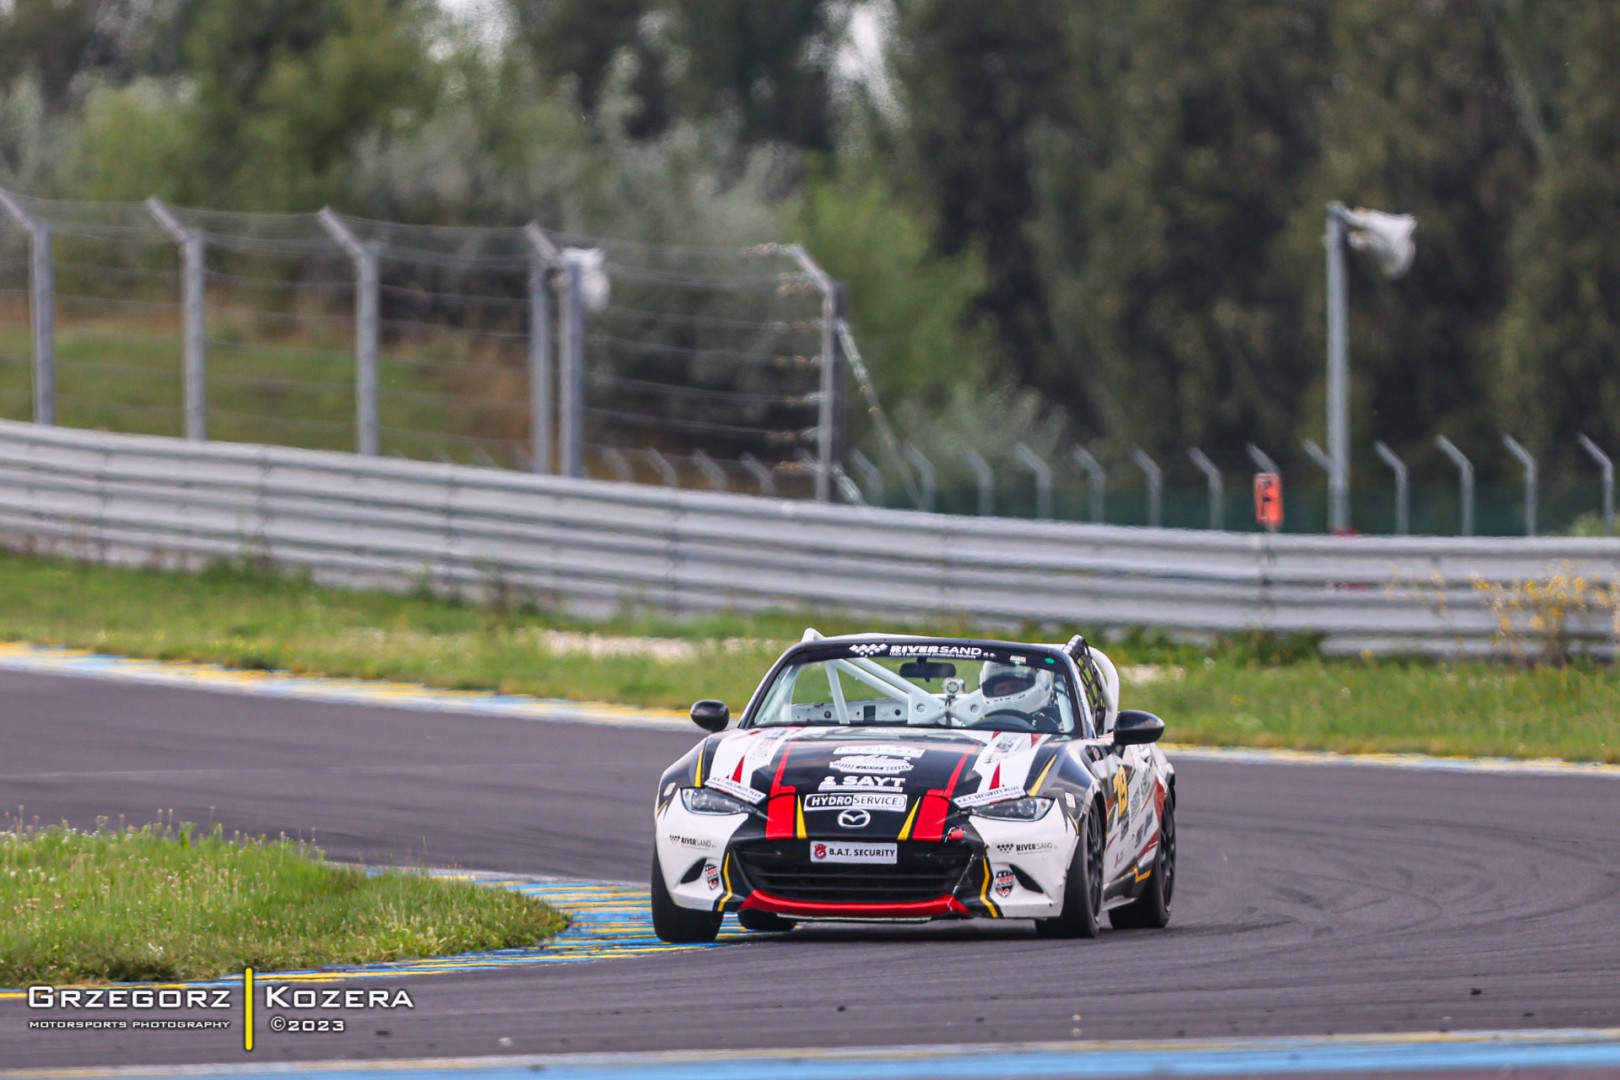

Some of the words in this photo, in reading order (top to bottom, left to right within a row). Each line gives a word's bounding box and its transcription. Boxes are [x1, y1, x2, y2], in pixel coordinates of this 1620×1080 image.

[889, 644, 982, 656] RIVERSAND
[819, 775, 836, 786] &
[842, 775, 906, 788] SAYT
[974, 788, 1003, 800] SECURITY
[829, 848, 852, 857] B.A.T.
[854, 848, 896, 857] SECURITY
